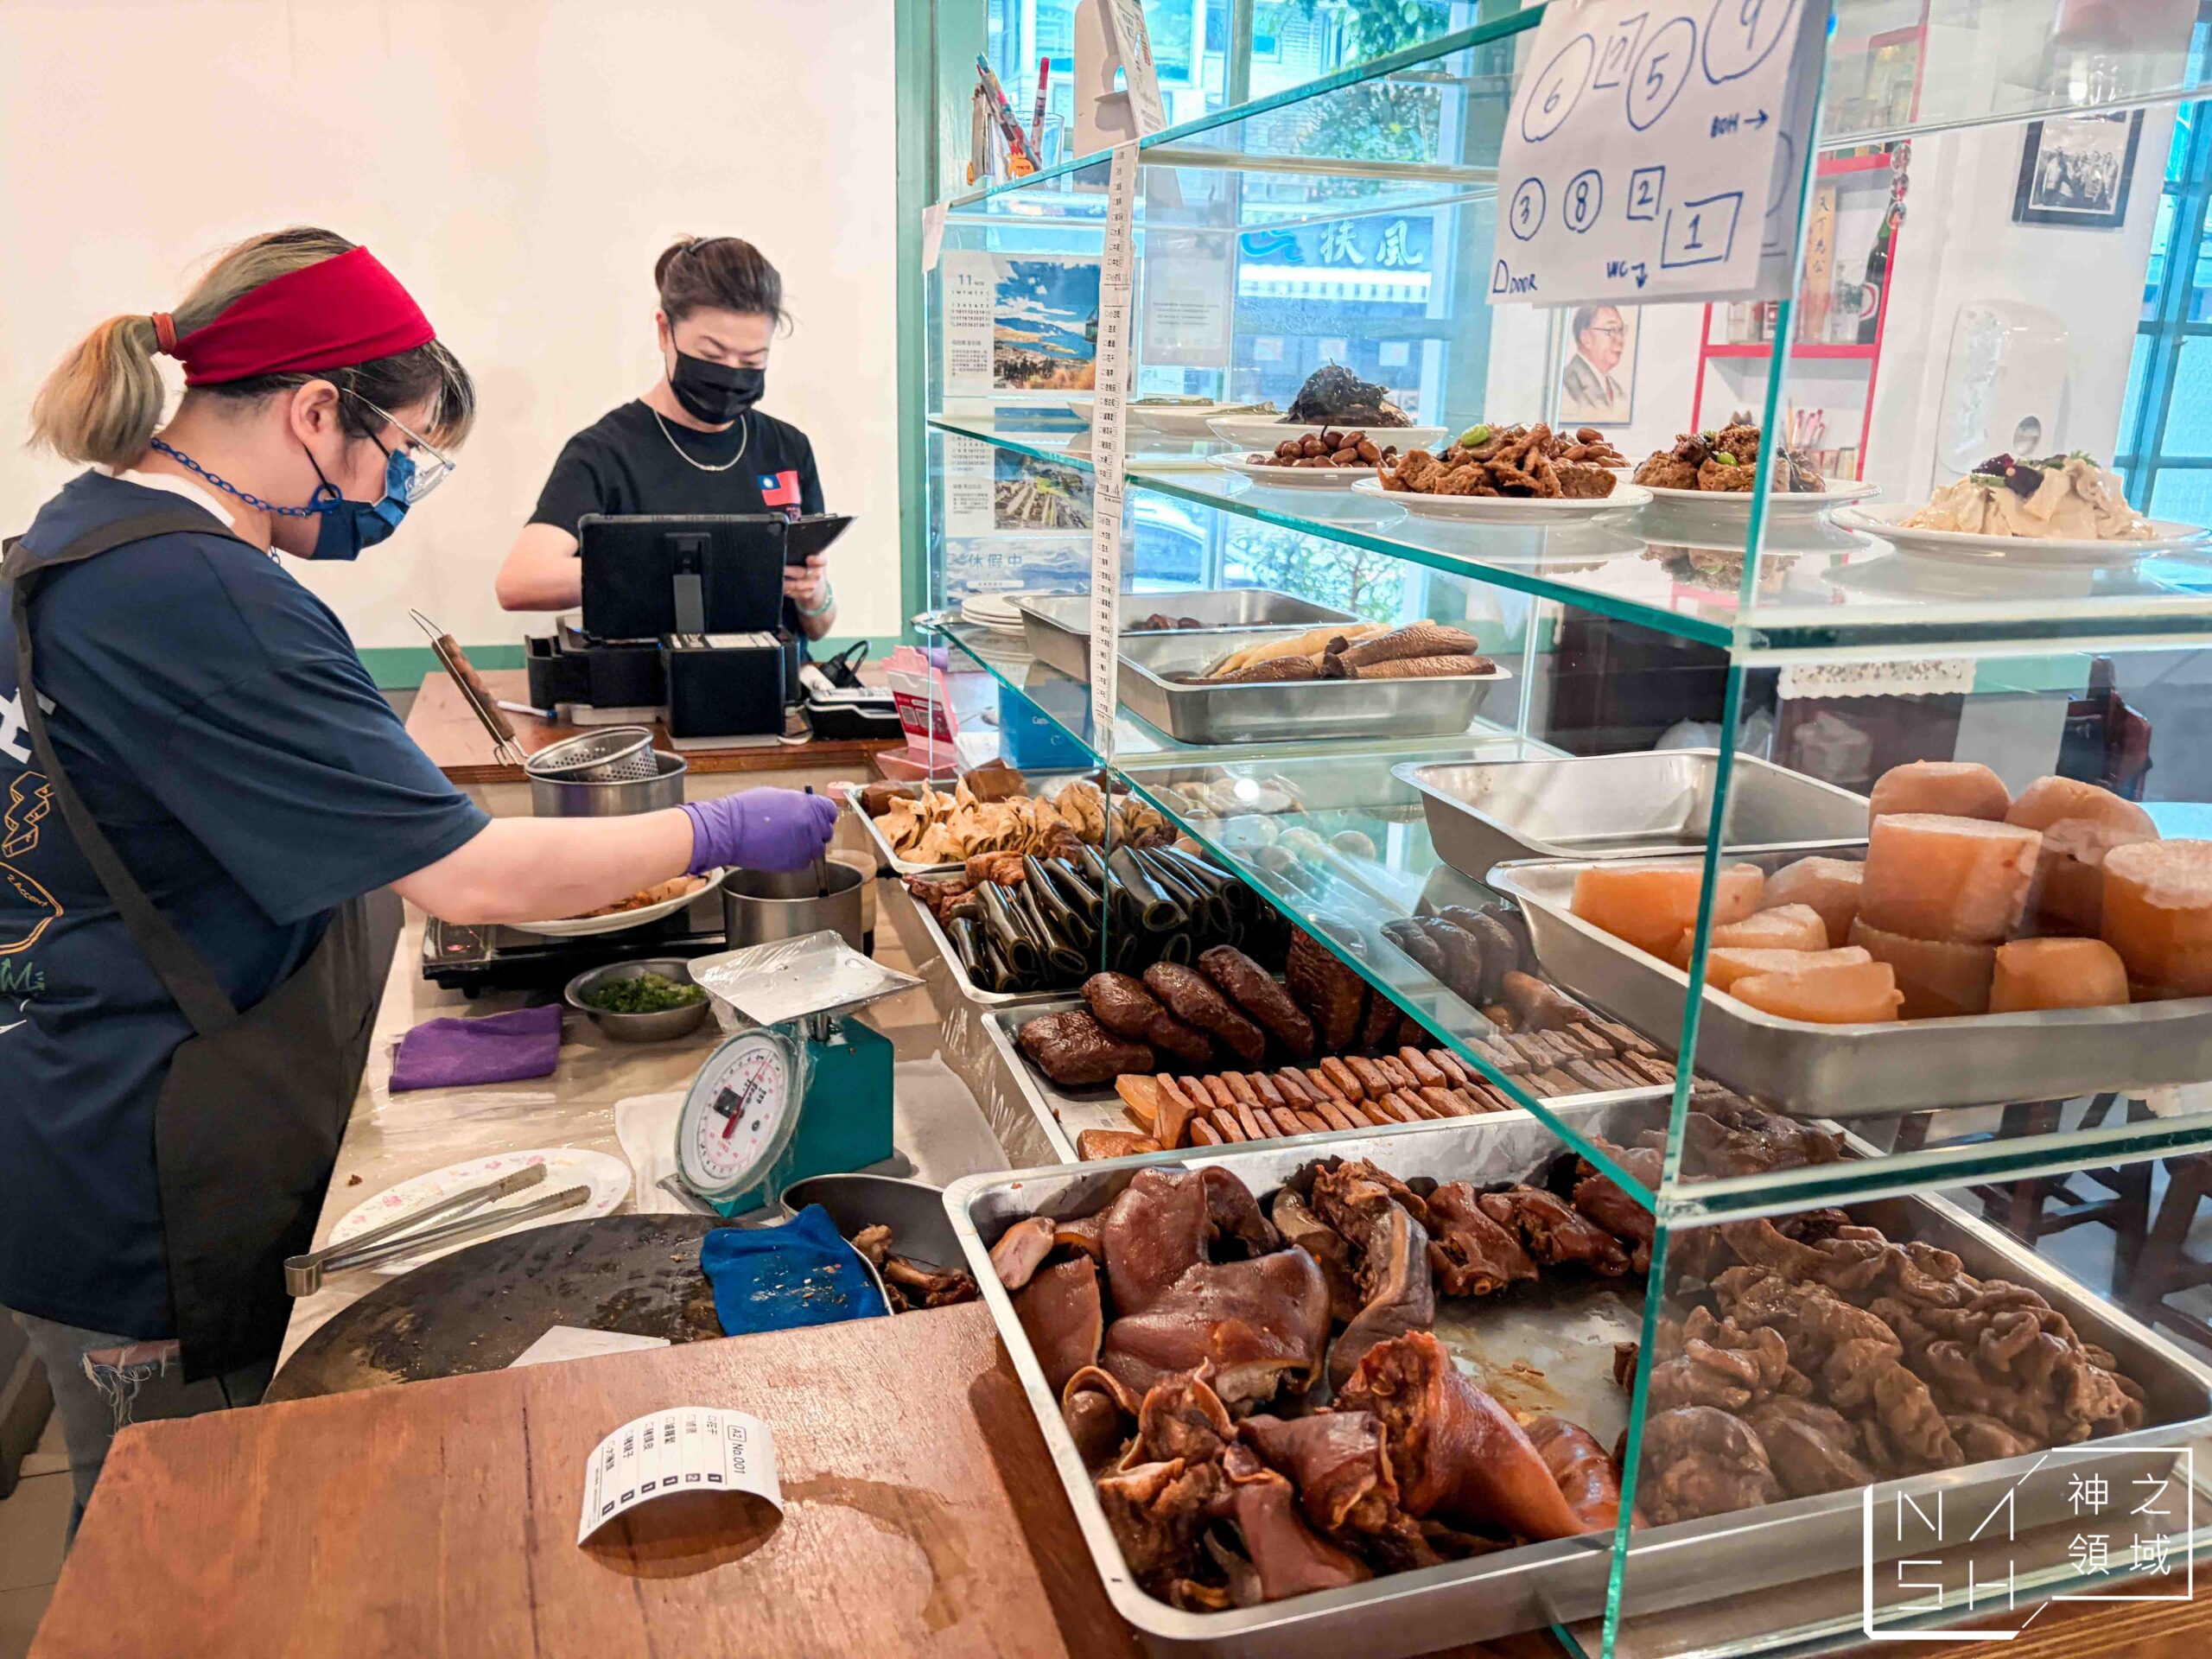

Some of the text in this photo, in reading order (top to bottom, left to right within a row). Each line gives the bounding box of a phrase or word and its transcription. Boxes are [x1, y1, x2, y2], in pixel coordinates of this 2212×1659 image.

[1647, 52, 1669, 101] 5
[1543, 78, 1563, 113] 6
[1575, 181, 1589, 222] 8
[1637, 180, 1654, 206] 2
[1520, 195, 1530, 225] 3
[1684, 213, 1702, 251] 1
[958, 275, 972, 286] 11
[1606, 260, 1629, 278] WC
[969, 553, 1022, 569] 休假中
[732, 1427, 746, 1474] A2 No.001
